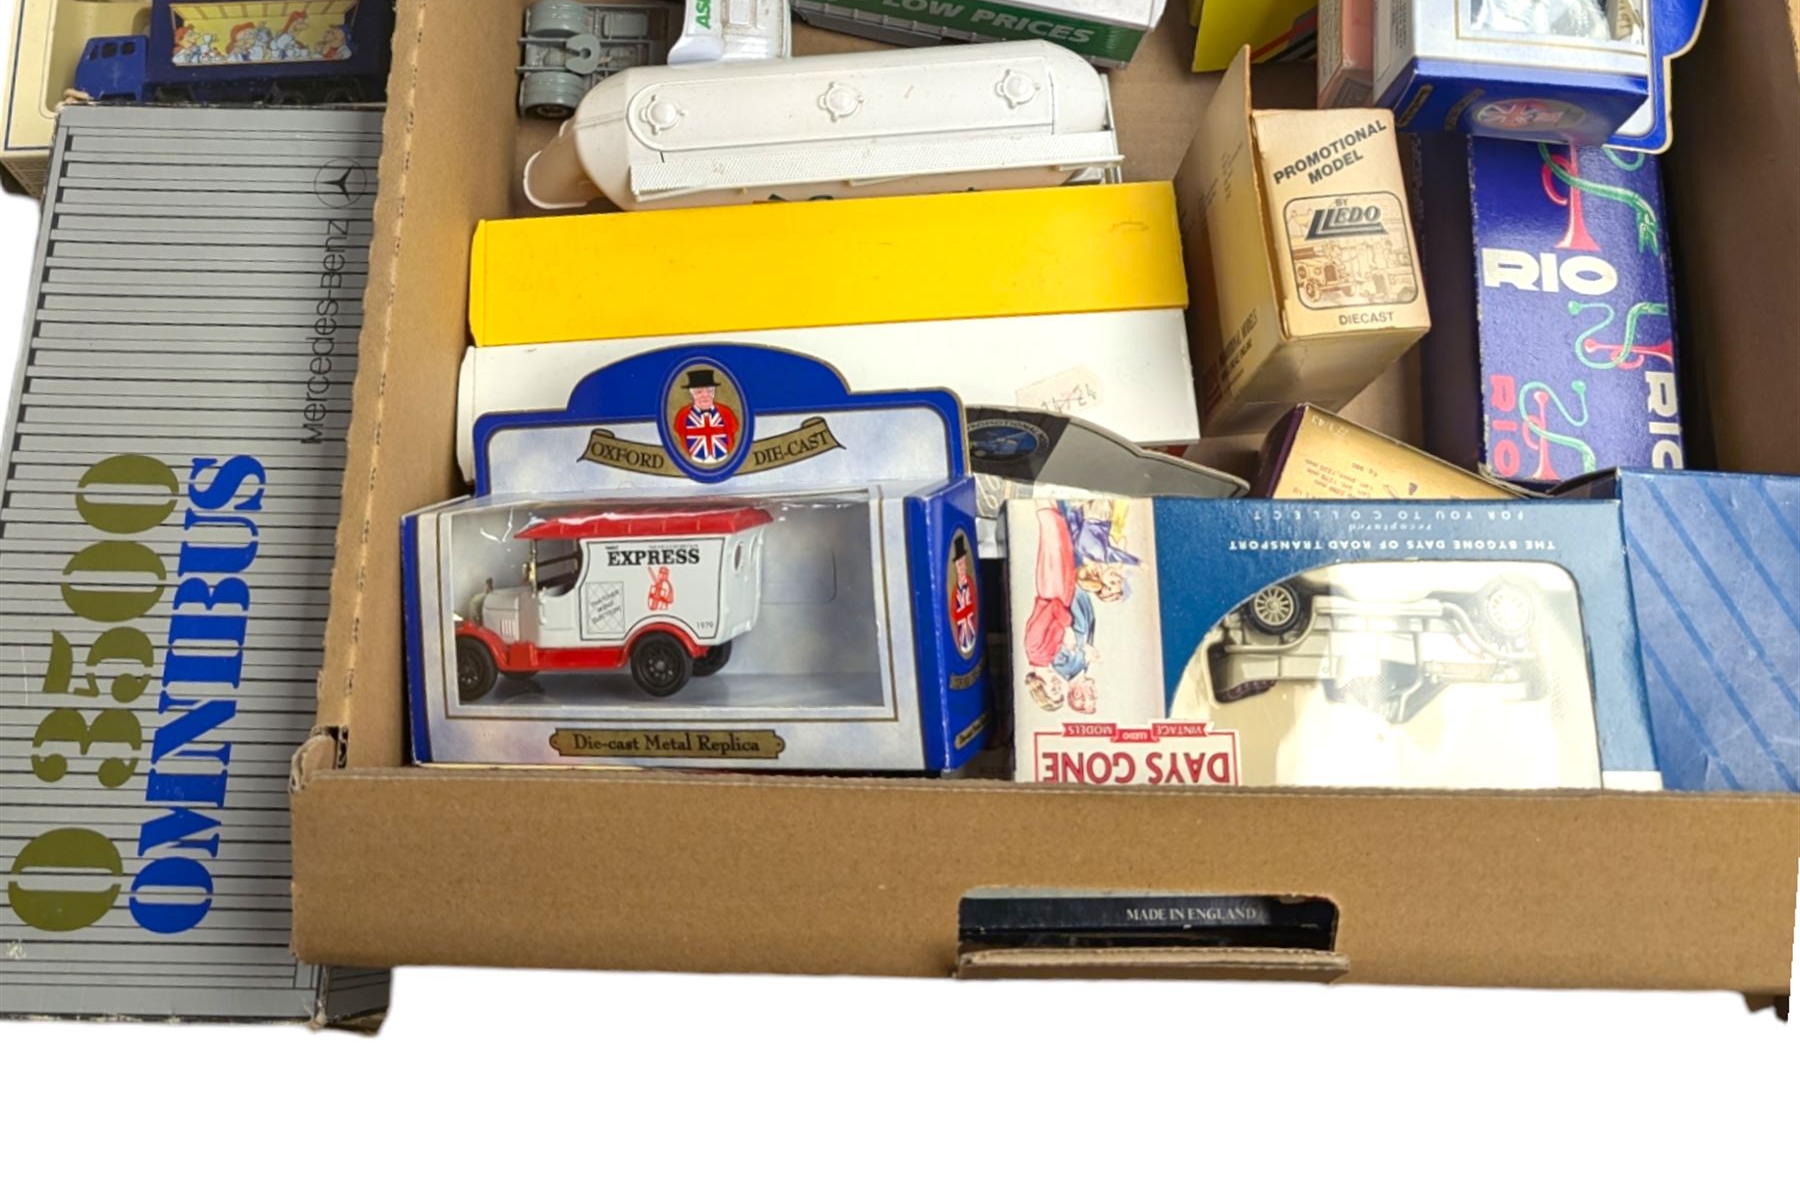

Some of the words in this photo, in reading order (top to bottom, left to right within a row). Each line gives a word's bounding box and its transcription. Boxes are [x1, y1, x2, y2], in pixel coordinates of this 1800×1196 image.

[971, 9, 1095, 43] PRICES
[1273, 120, 1387, 184] PROMOTIONAL
[1308, 149, 1364, 184] MODEL
[1305, 206, 1388, 240] LLEDO
[1481, 248, 1618, 295] RIO
[1339, 312, 1394, 326] DIECAST
[301, 219, 349, 445] Mercedes-Benz
[1490, 375, 1520, 477] RIO
[590, 442, 664, 470] OXFORD
[754, 431, 830, 466] DIE-CAST
[1398, 510, 1421, 520] TO
[1436, 511, 1473, 520] YOU
[1488, 510, 1524, 520] FOR
[1228, 540, 1322, 550] TRANSPORT
[1328, 539, 1371, 550] ROAD
[1379, 539, 1398, 550] OF
[1407, 539, 1445, 550] DAYS
[1454, 540, 1517, 550] BYGONE
[1526, 540, 1556, 550] THE
[607, 548, 700, 566] EXPRESS
[31, 454, 180, 790] 3500
[128, 454, 267, 934] OMNIBUS
[1068, 724, 1114, 735] MODELS
[1157, 724, 1203, 735] VINTAGE
[573, 734, 639, 752] Die-cast
[645, 735, 691, 753] Metal
[698, 736, 760, 755] Replica
[1042, 752, 1136, 784] GONE
[1146, 752, 1230, 784] DAYS
[1126, 908, 1166, 921] MADE
[1169, 908, 1185, 921] IN
[1188, 907, 1256, 921] ENGLAND
